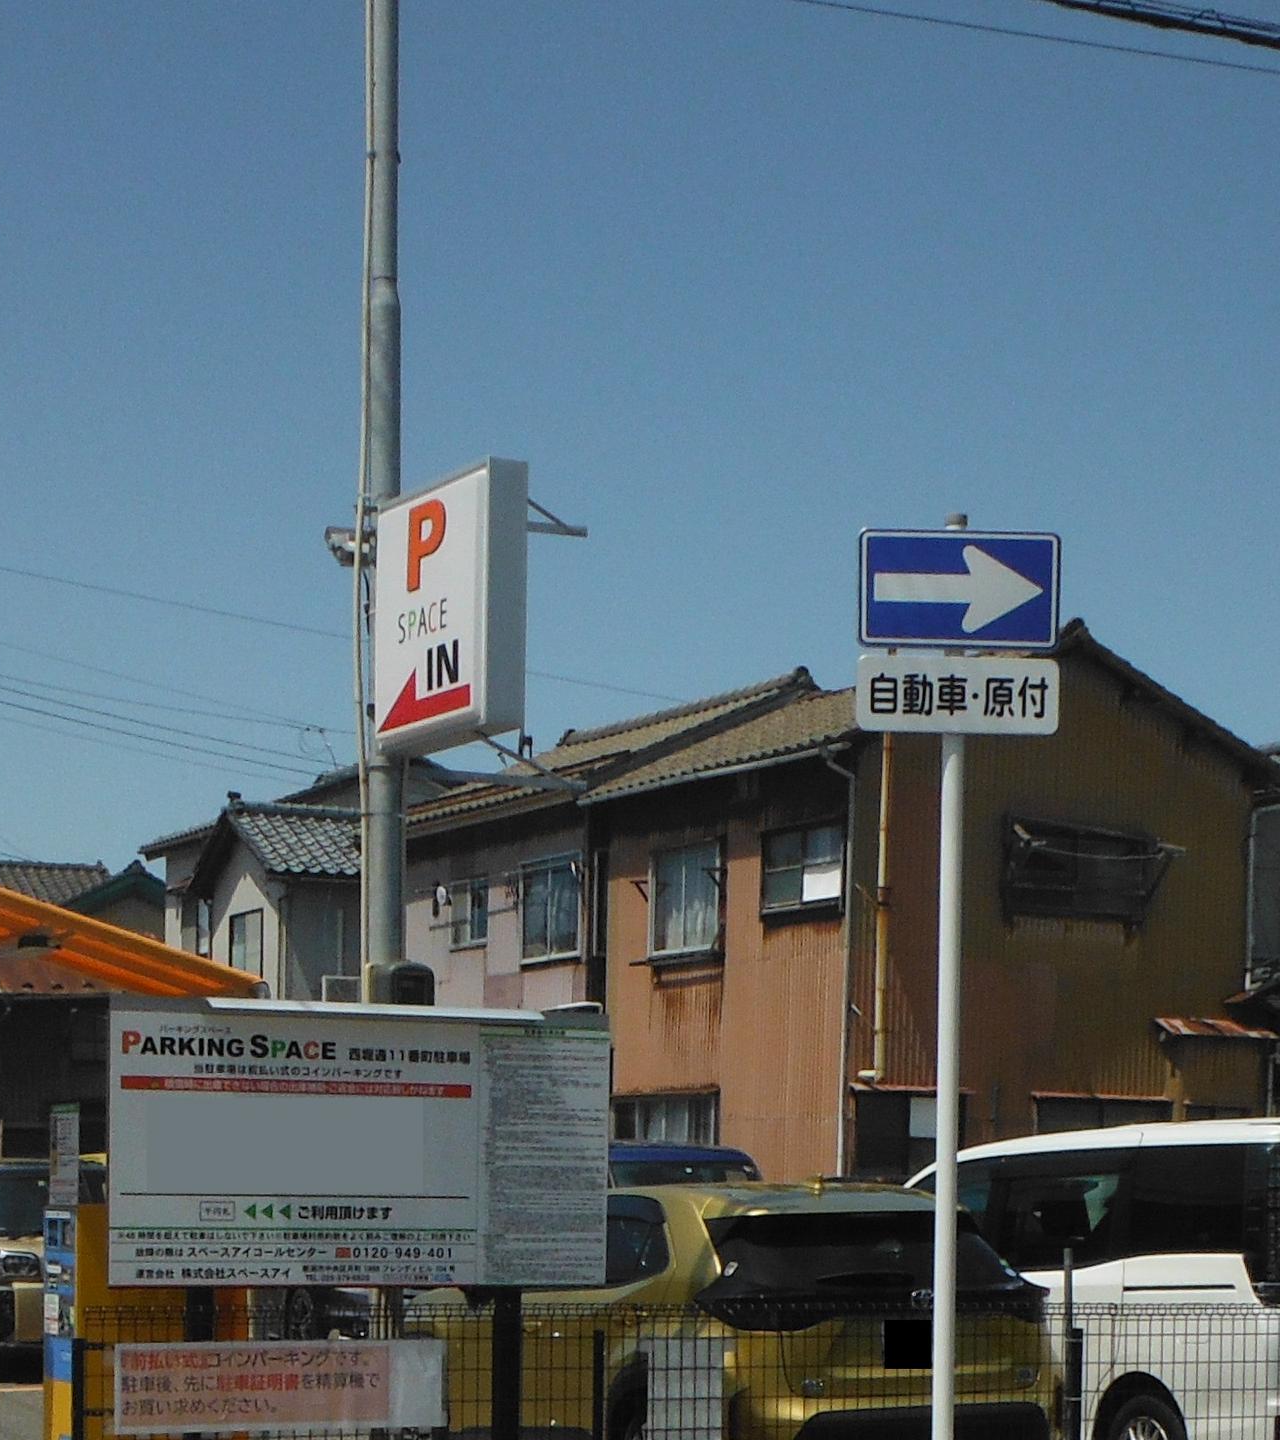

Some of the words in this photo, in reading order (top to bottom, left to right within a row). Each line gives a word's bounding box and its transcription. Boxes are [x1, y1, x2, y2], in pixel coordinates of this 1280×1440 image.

[406, 499, 447, 592] P
[398, 598, 447, 644] SPACE
[426, 639, 459, 691] IN
[870, 673, 1049, 719] 自動車・原付
[122, 1030, 245, 1058] PARKING
[250, 1034, 337, 1060] SPACE
[297, 1205, 393, 1221] ご利用頂けます
[187, 1247, 327, 1259] スペースアイコールセンター
[353, 1247, 452, 1260] 0120-949-401
[181, 1267, 291, 1280] 株式会社スペースアイ
[121, 1398, 279, 1417] お買い求めください。
